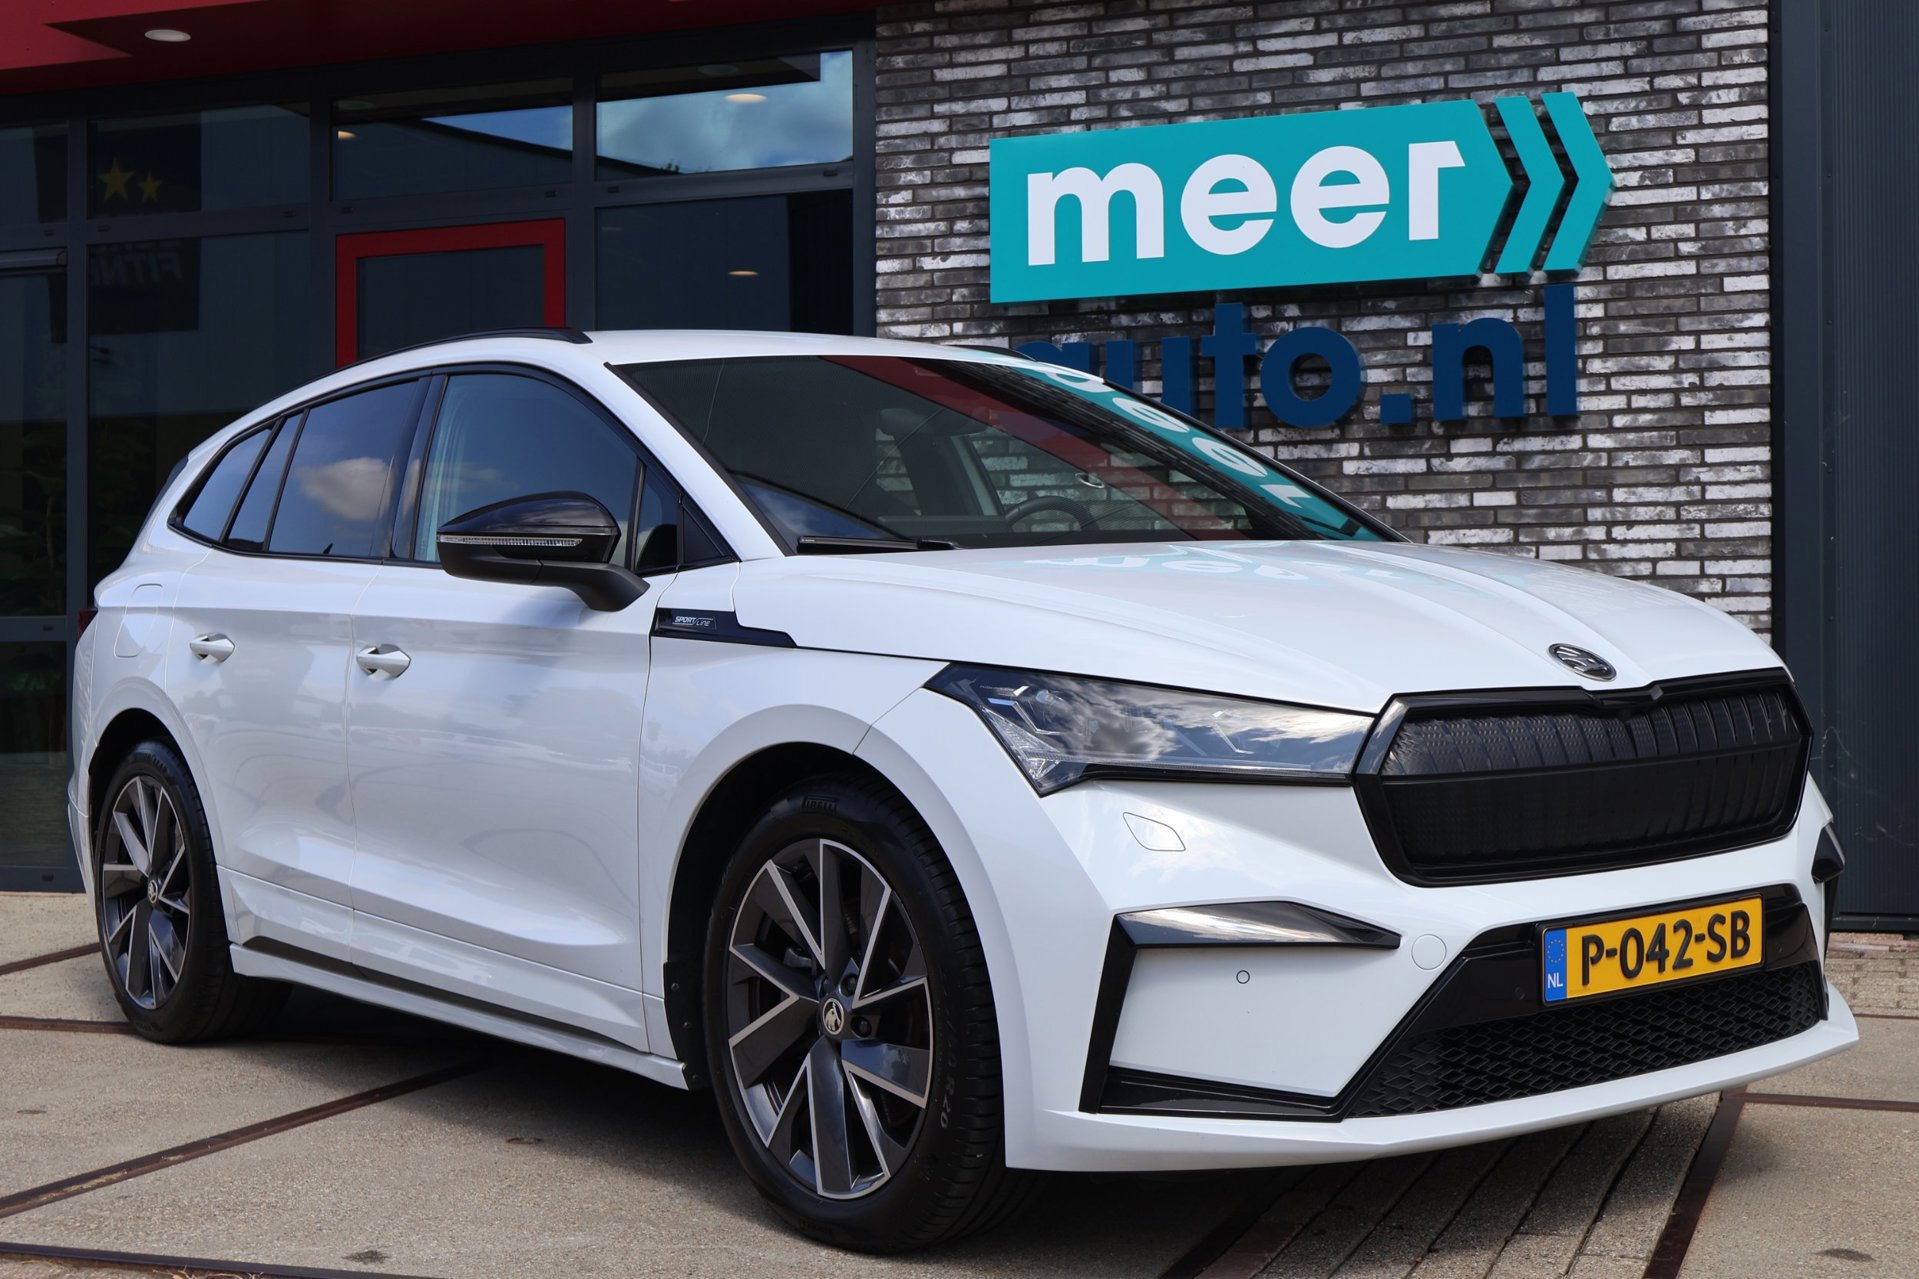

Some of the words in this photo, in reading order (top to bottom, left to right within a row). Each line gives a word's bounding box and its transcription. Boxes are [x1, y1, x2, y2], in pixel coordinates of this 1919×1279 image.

[1028, 141, 1466, 266] meer
[1547, 972, 1564, 989] NL
[1581, 909, 1751, 987] P-042-SB
